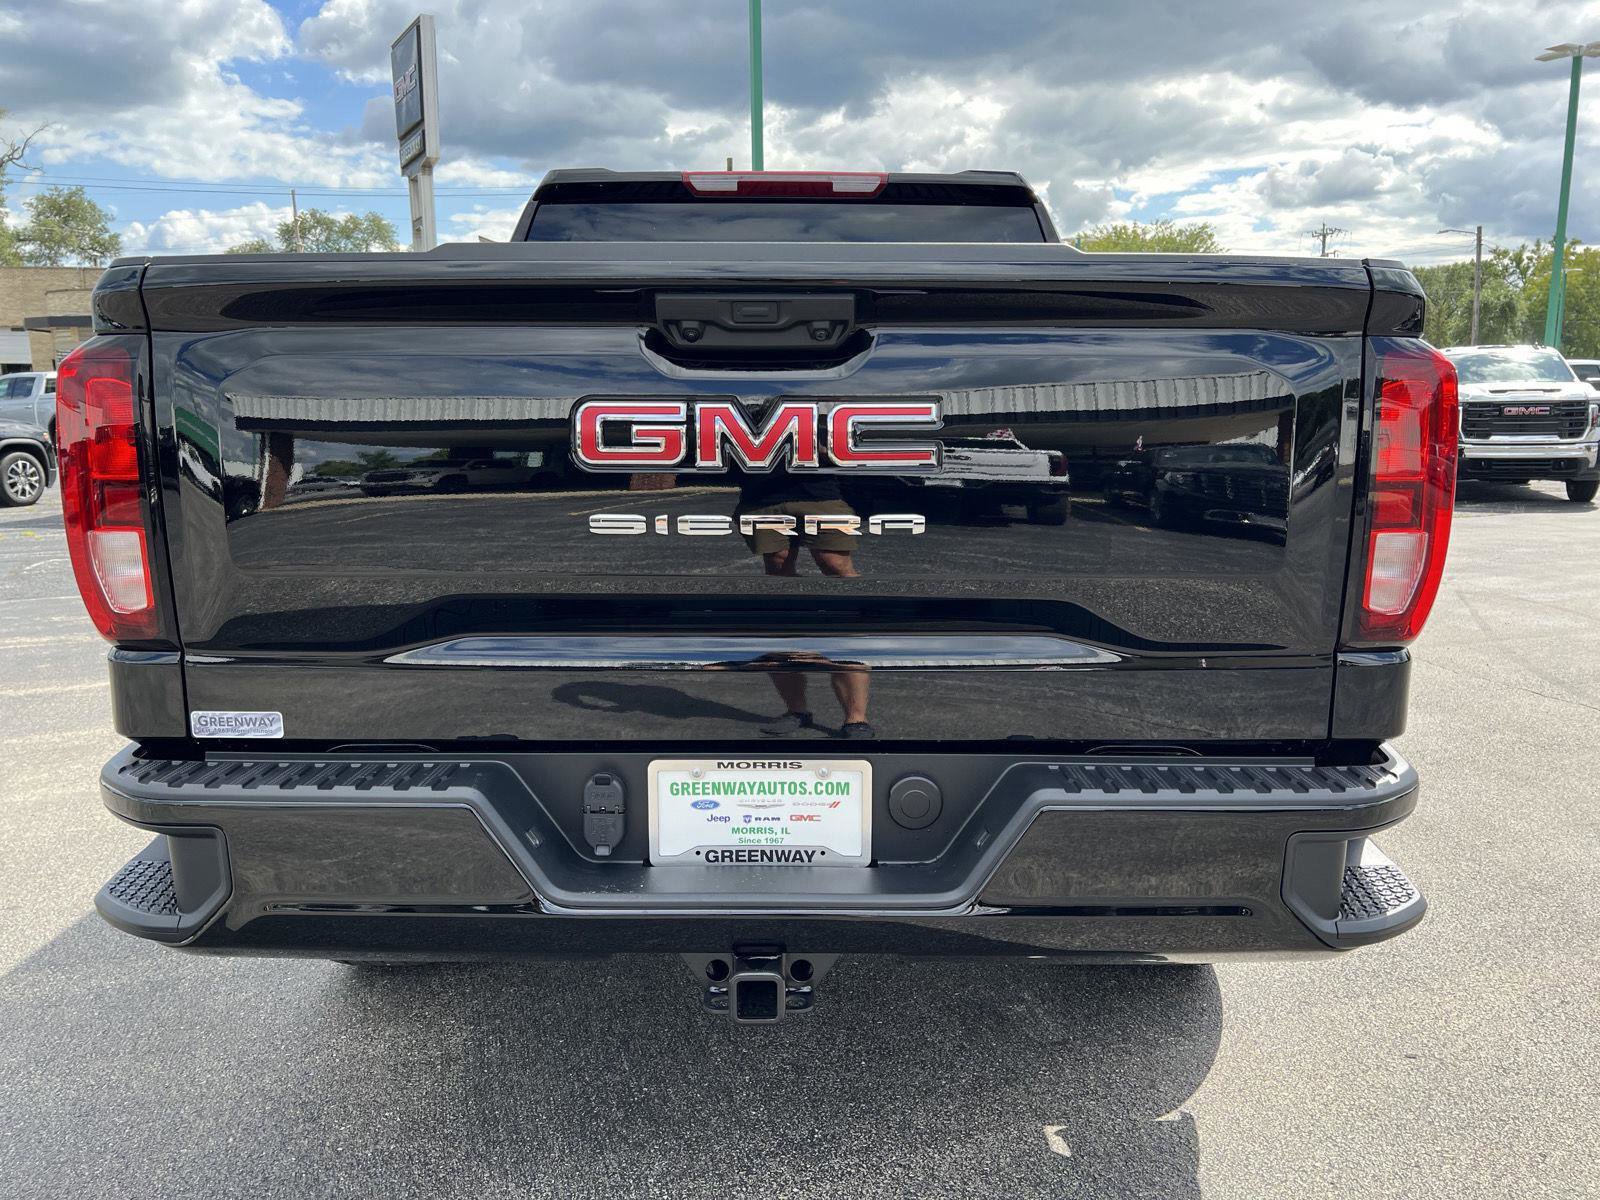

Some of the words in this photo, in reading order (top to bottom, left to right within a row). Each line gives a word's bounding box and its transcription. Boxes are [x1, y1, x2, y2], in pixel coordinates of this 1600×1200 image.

[394, 64, 416, 103] GMC
[1504, 406, 1550, 416] GMC
[574, 399, 942, 470] GMC
[588, 513, 926, 537] SIERRA
[197, 715, 275, 728] GREENWAY
[717, 761, 803, 770] MORRIS
[669, 781, 850, 796] GREENWAYAUTOS.COM
[697, 800, 714, 810] Ford
[706, 814, 731, 824] Jeep
[789, 814, 822, 822] GMC
[731, 827, 778, 836] MORRIS,
[781, 827, 791, 835] IL
[705, 850, 816, 863] GREENWAY
